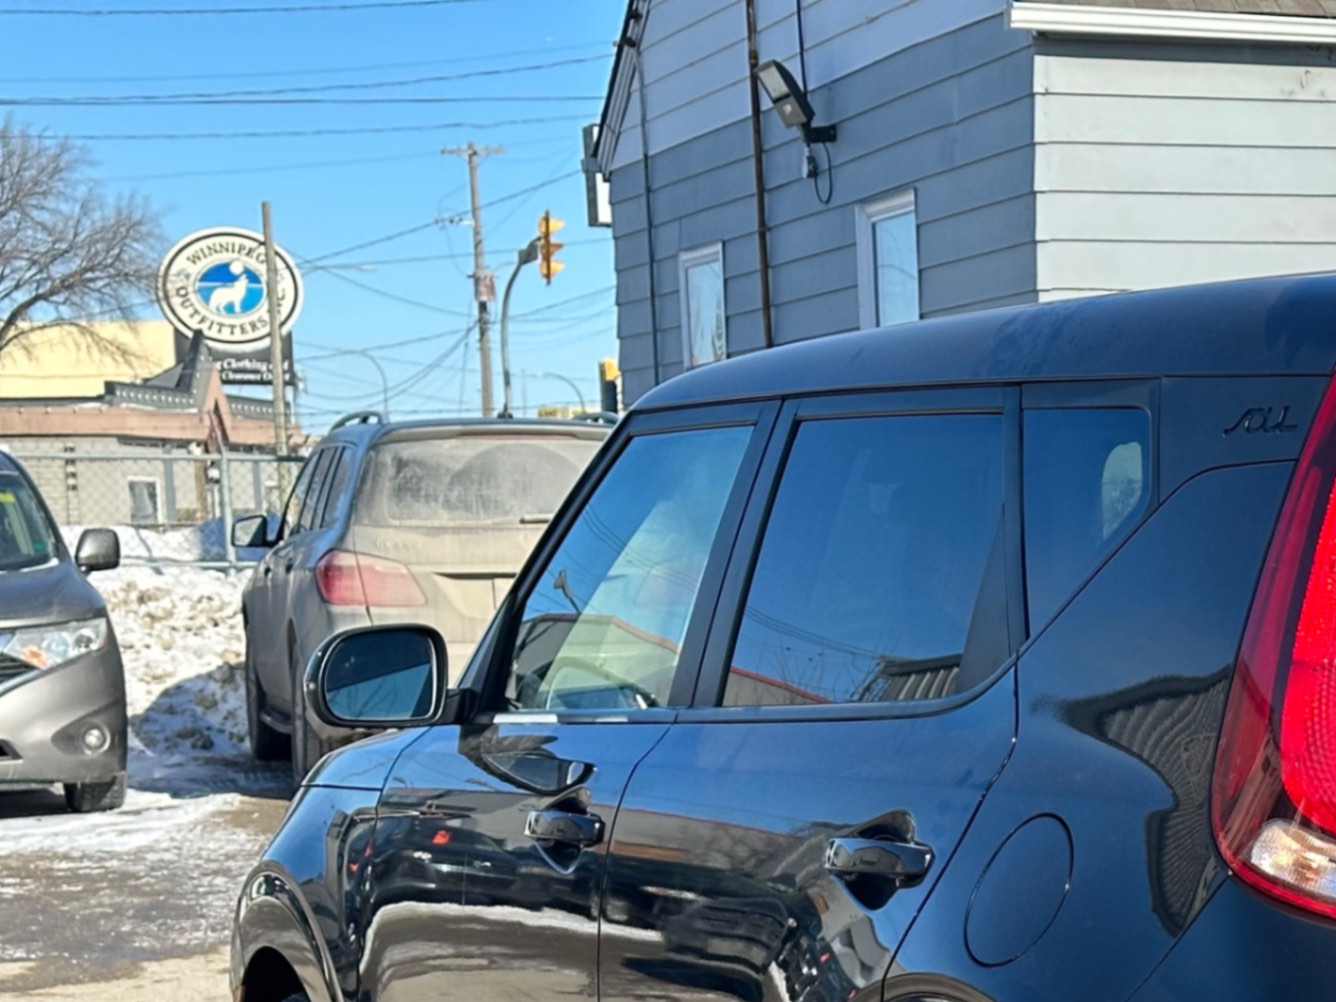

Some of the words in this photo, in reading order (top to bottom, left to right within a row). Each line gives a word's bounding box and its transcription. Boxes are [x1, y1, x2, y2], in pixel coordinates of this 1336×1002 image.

[187, 241, 266, 266] WINNIPEG
[175, 286, 269, 336] OUTFITTERS
[1222, 405, 1298, 437] SOUL
